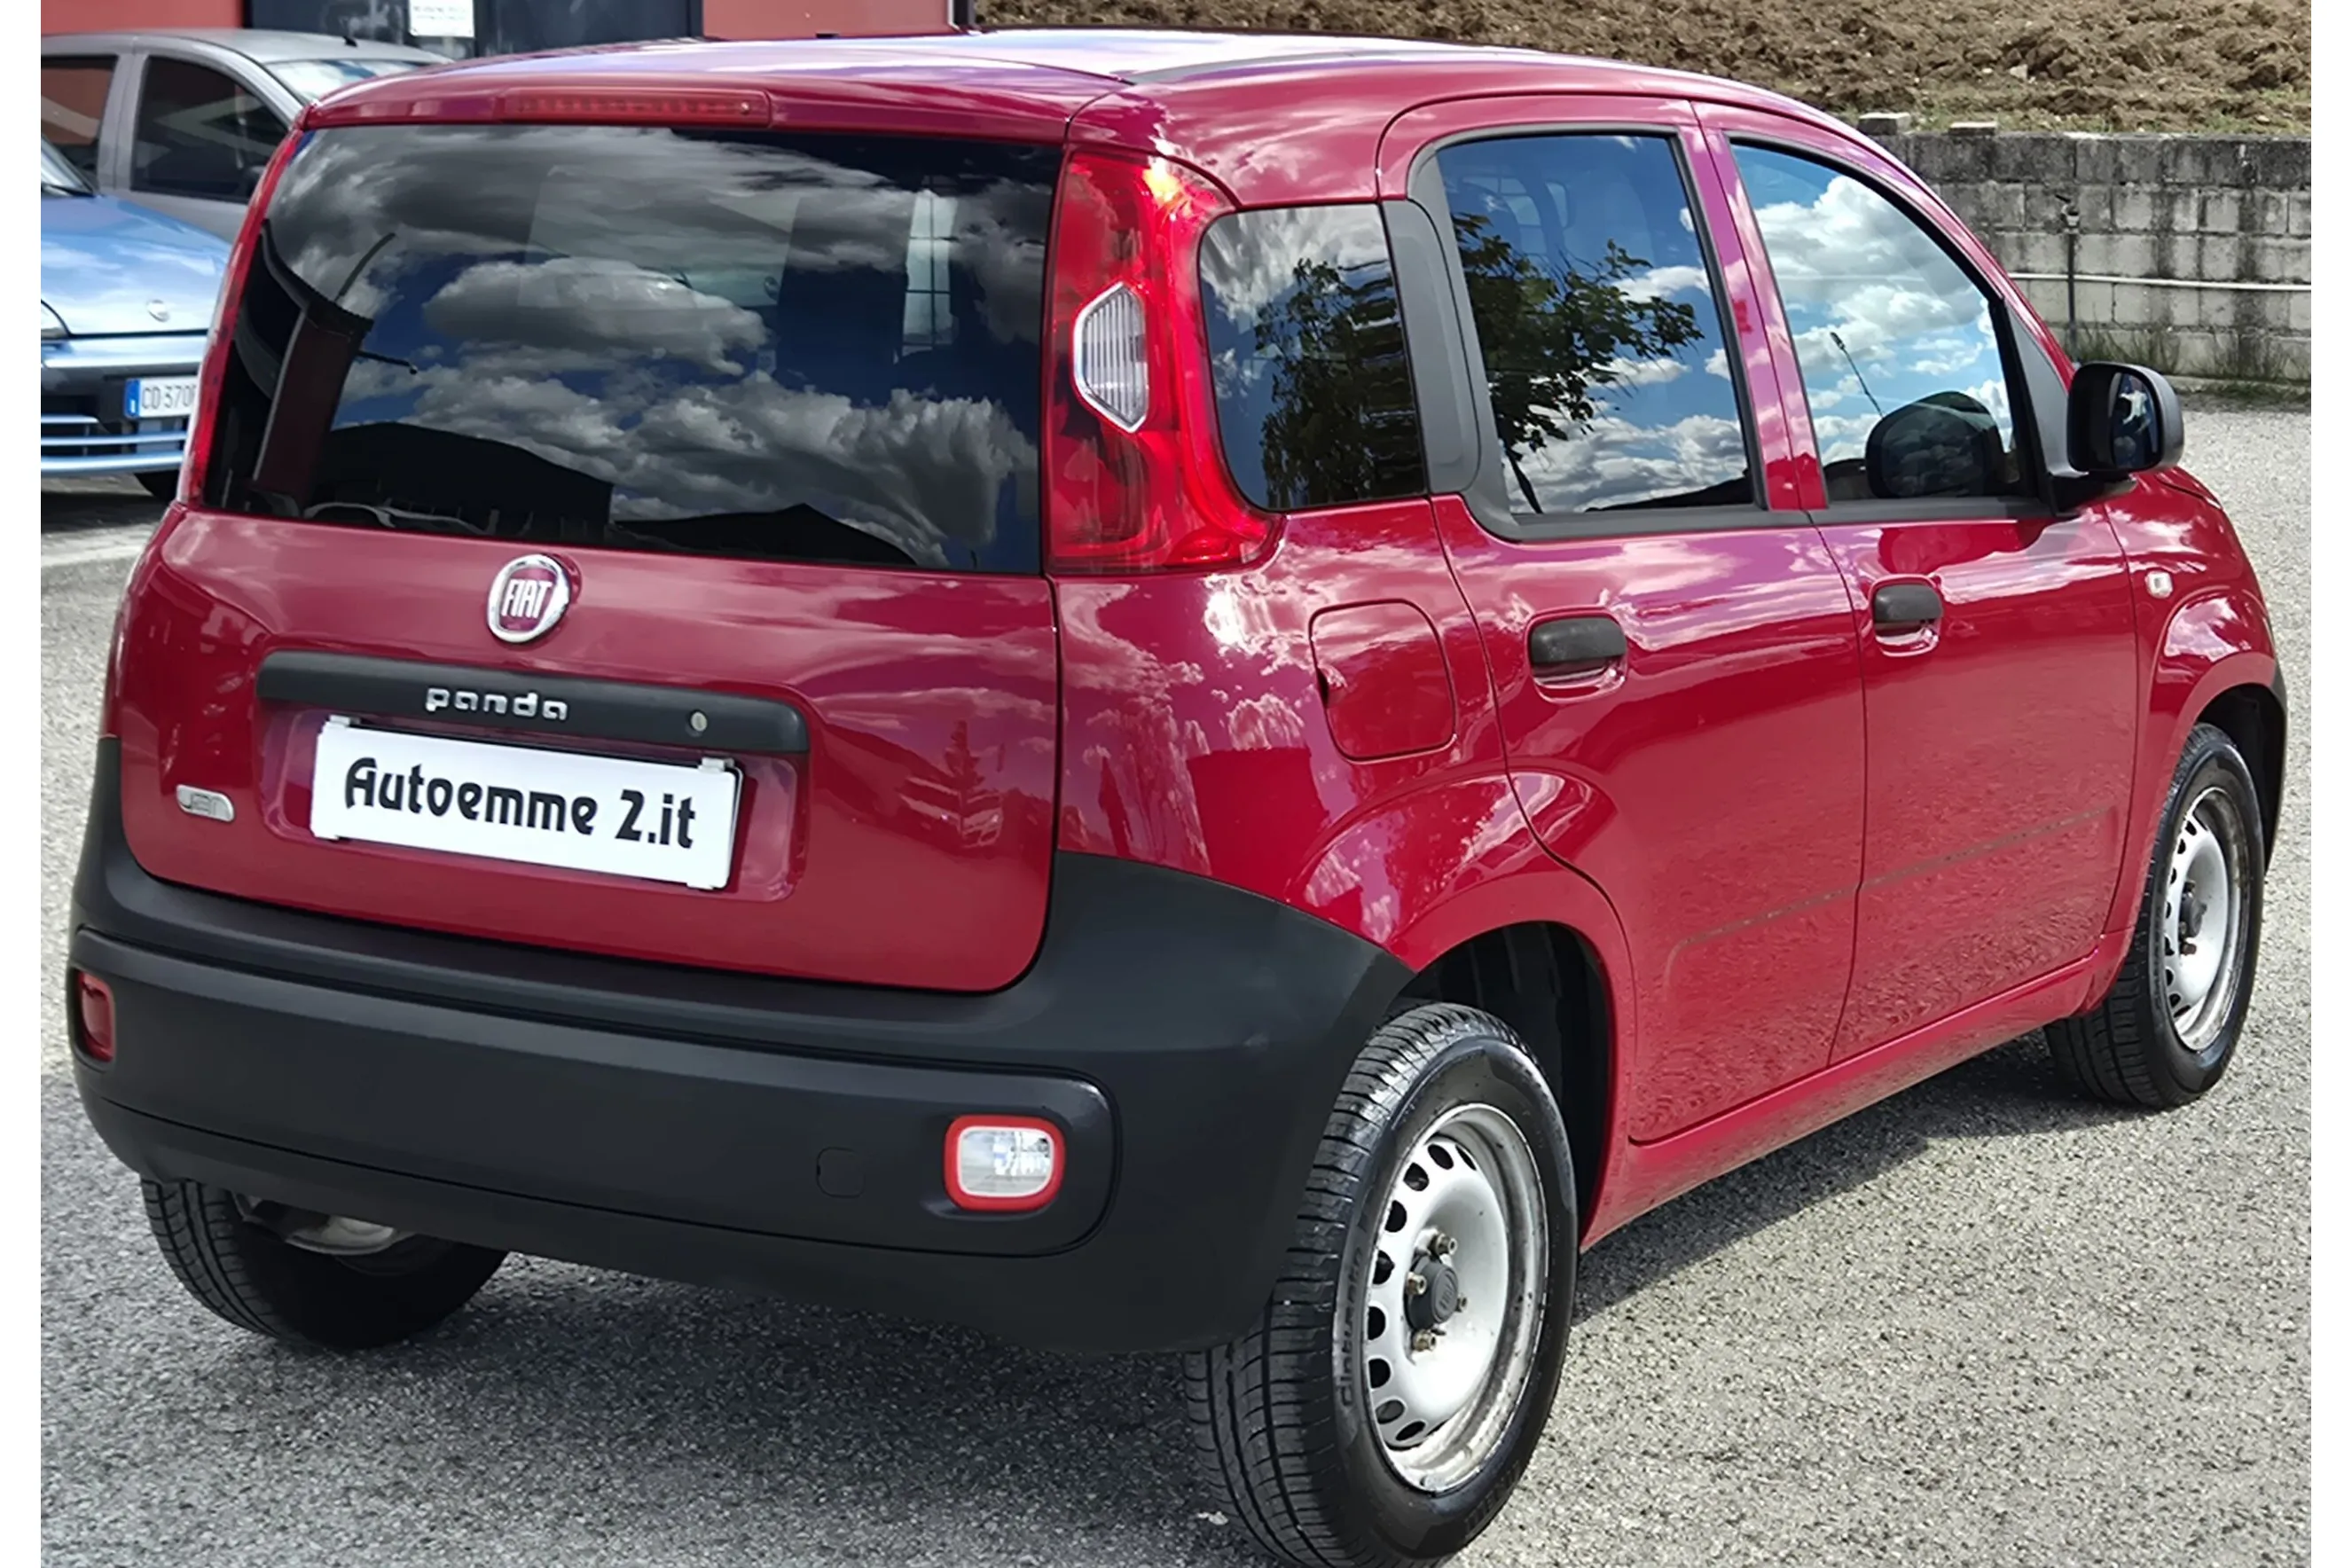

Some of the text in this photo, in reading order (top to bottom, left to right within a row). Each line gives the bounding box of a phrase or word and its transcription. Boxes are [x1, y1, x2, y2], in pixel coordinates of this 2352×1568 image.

[501, 579, 553, 619] FIAT
[425, 687, 568, 721] panda
[344, 757, 696, 850] Autoemme 2.it
